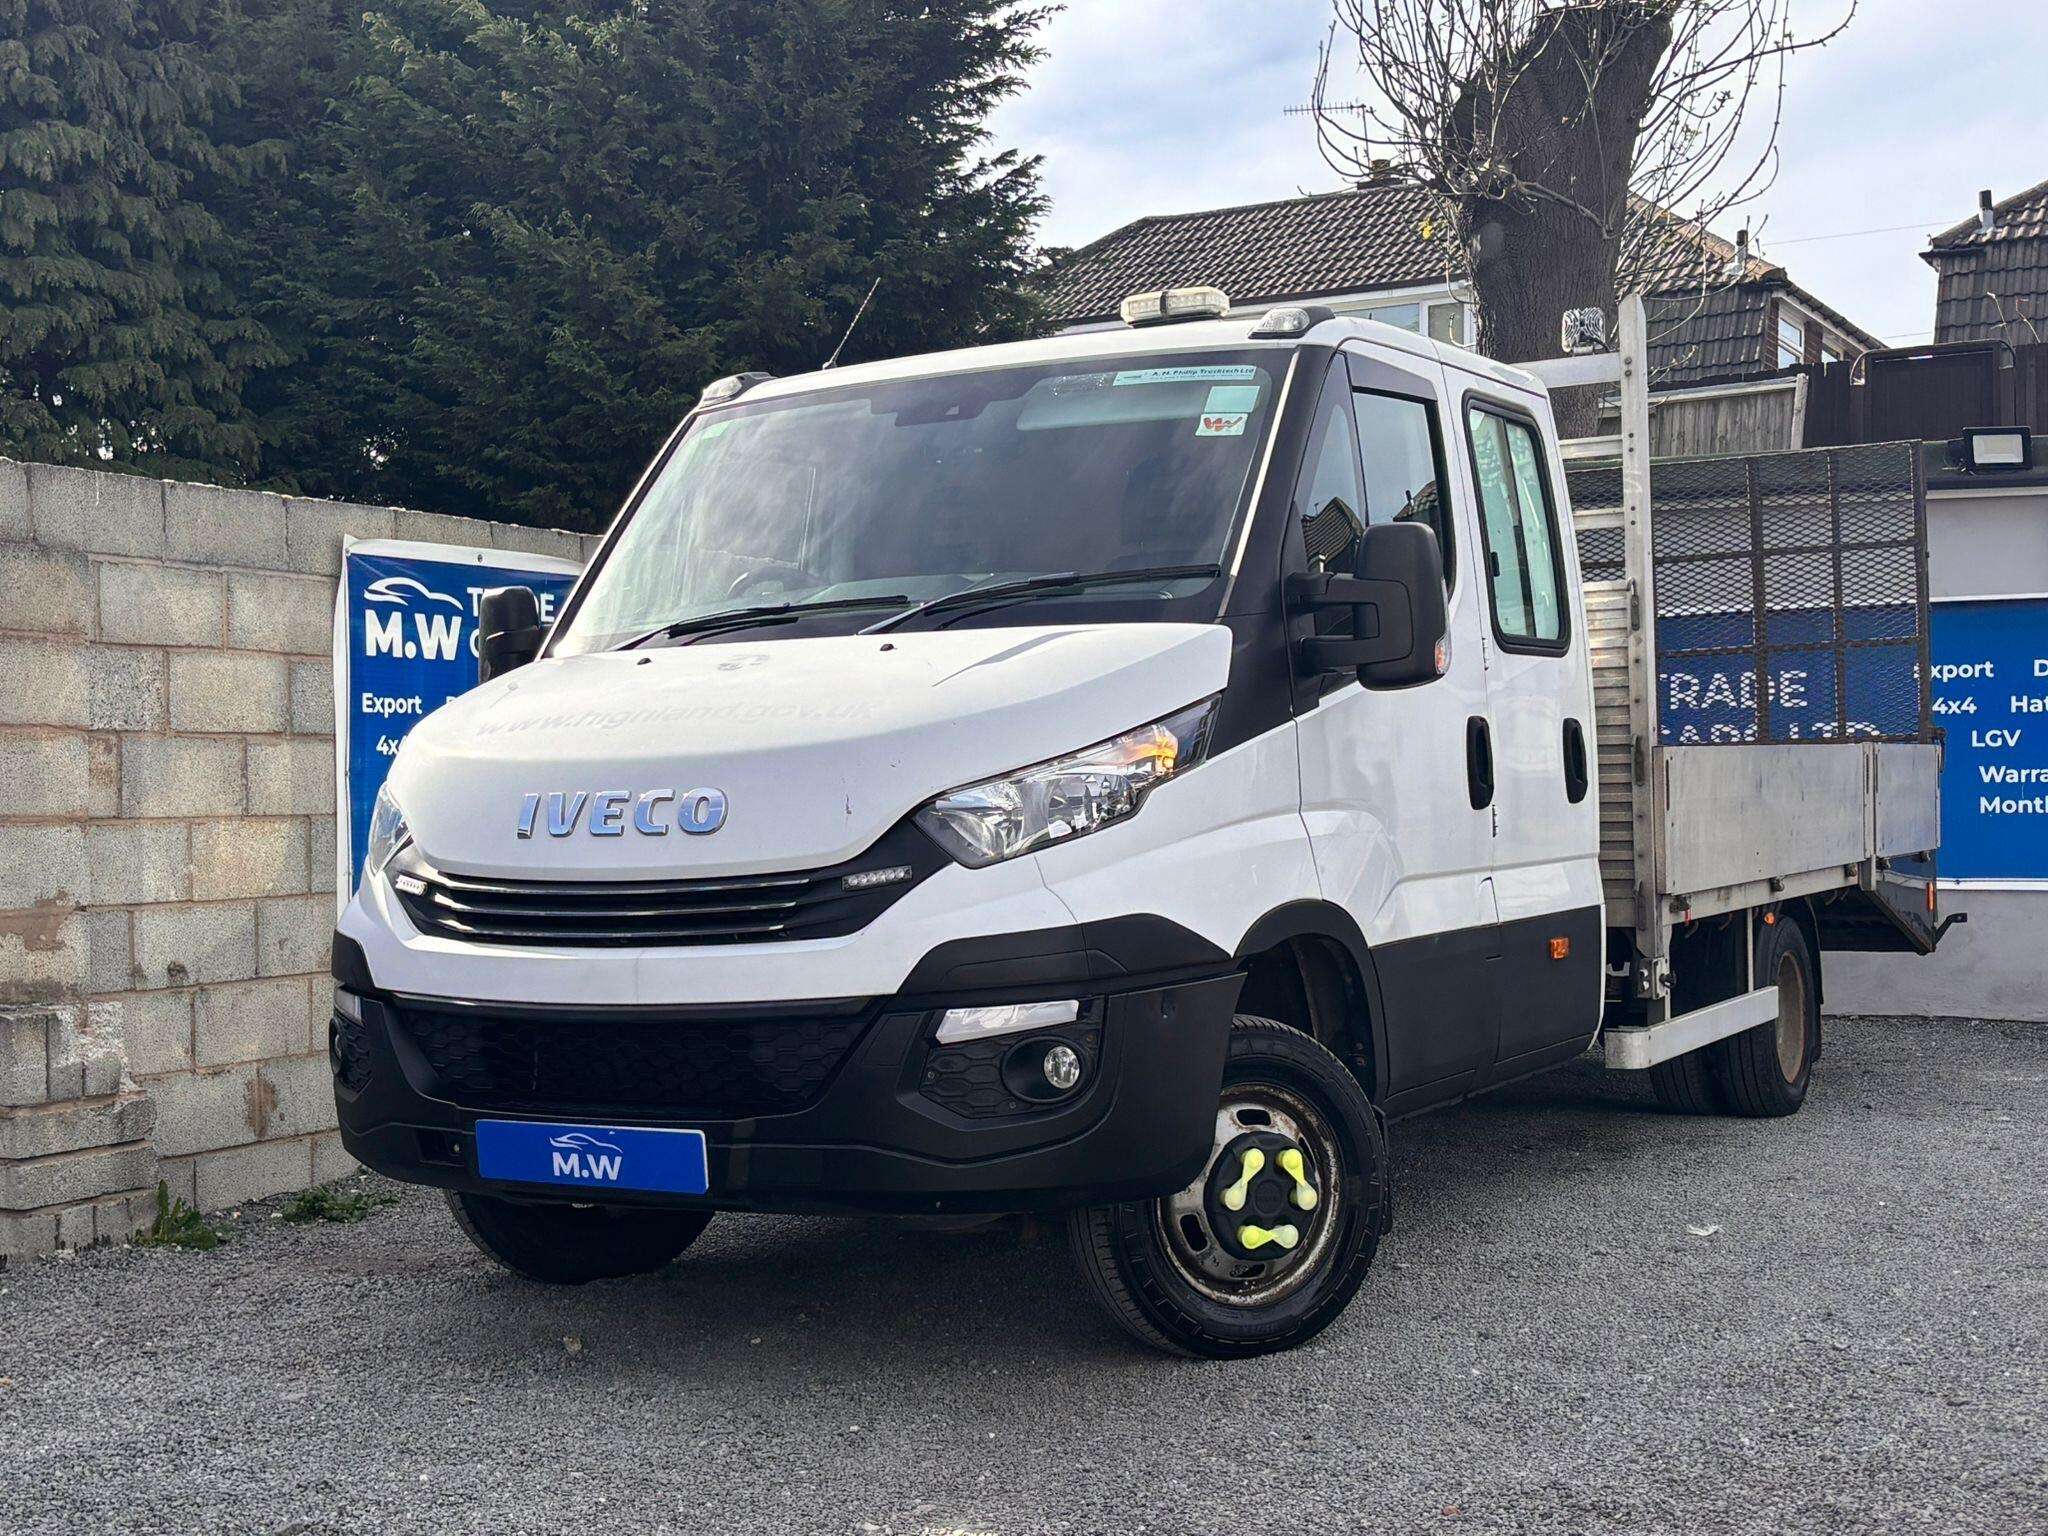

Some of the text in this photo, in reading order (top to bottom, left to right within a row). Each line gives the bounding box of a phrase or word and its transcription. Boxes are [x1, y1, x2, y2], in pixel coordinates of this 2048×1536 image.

[365, 609, 462, 660] M.W
[1914, 660, 1995, 682] xport
[1660, 671, 1808, 710] RADE
[362, 692, 422, 718] Export
[1932, 696, 1977, 714] 4x4
[375, 734, 407, 755] 4x
[1971, 729, 2021, 748] LGV
[517, 787, 730, 839] IVECO
[1980, 795, 2048, 814] Mont
[552, 1151, 622, 1181] M.W
